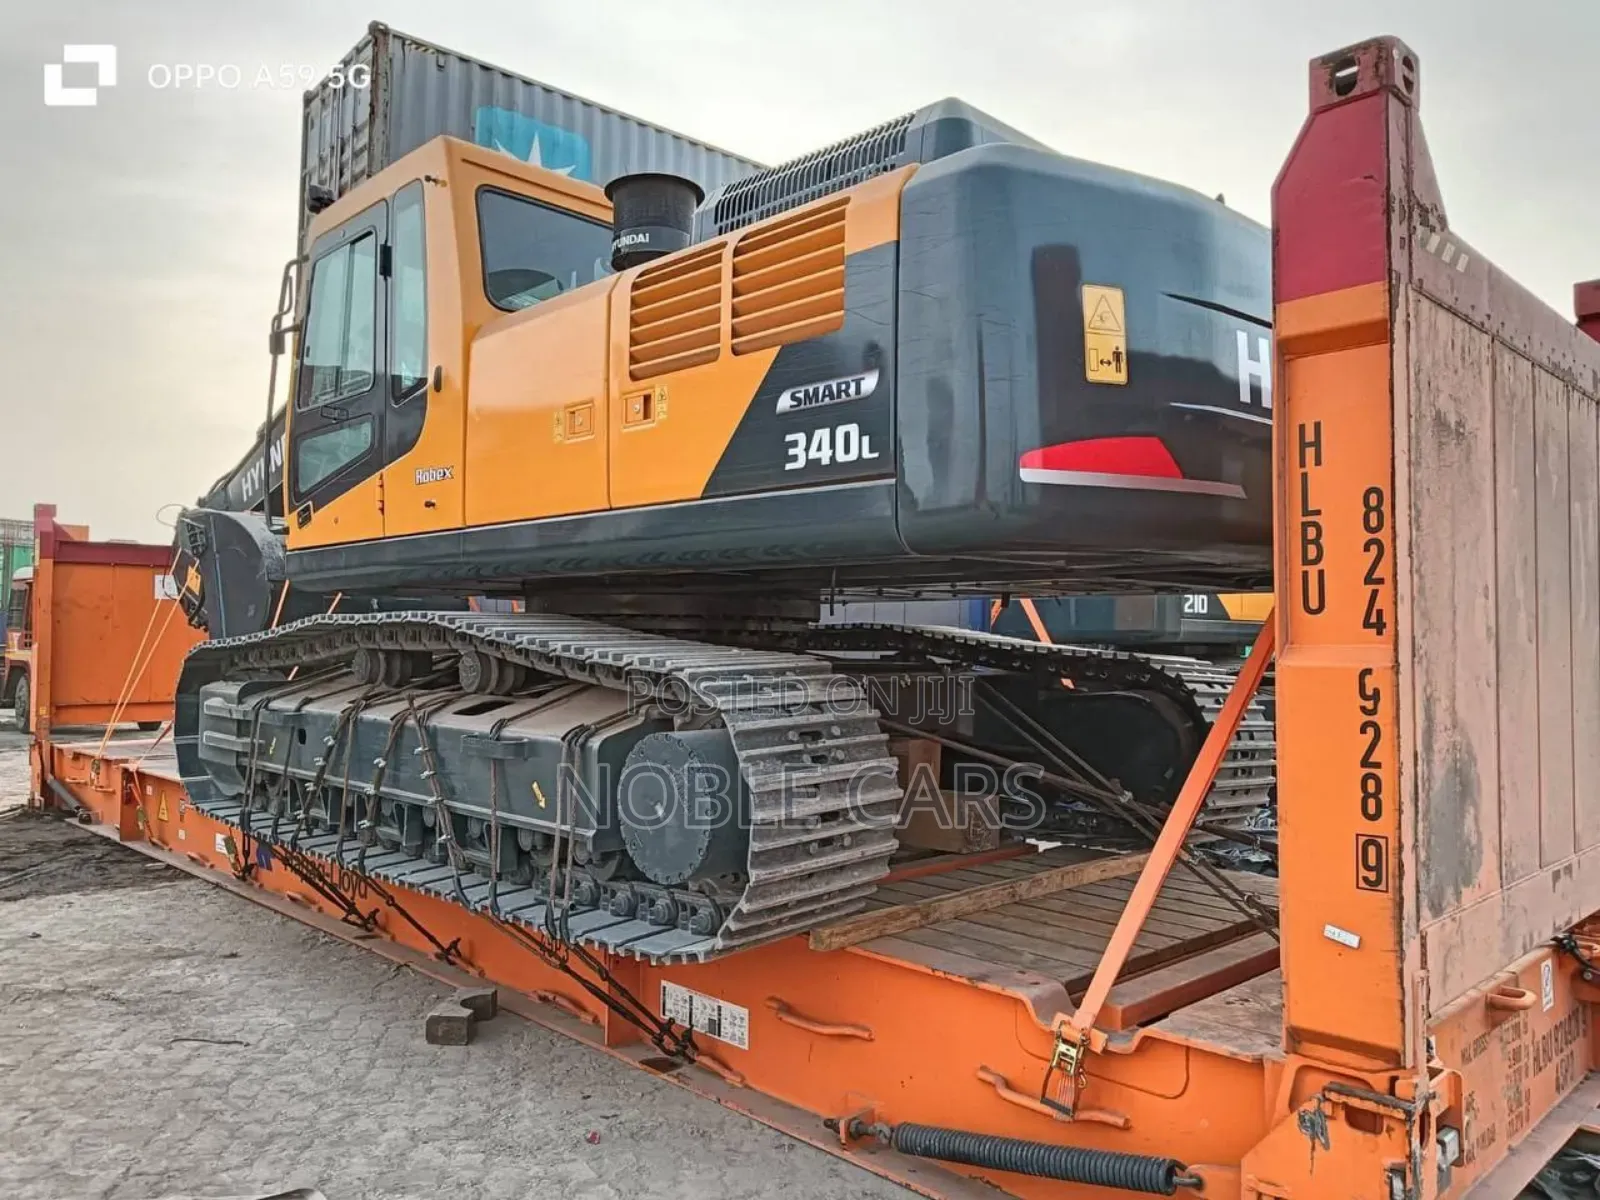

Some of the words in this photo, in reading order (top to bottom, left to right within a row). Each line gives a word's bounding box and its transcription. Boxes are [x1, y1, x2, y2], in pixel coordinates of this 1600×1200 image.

[789, 376, 866, 409] SMART
[784, 422, 880, 471] 340L
[1298, 421, 1326, 615] HLBU
[1183, 594, 1208, 614] 210
